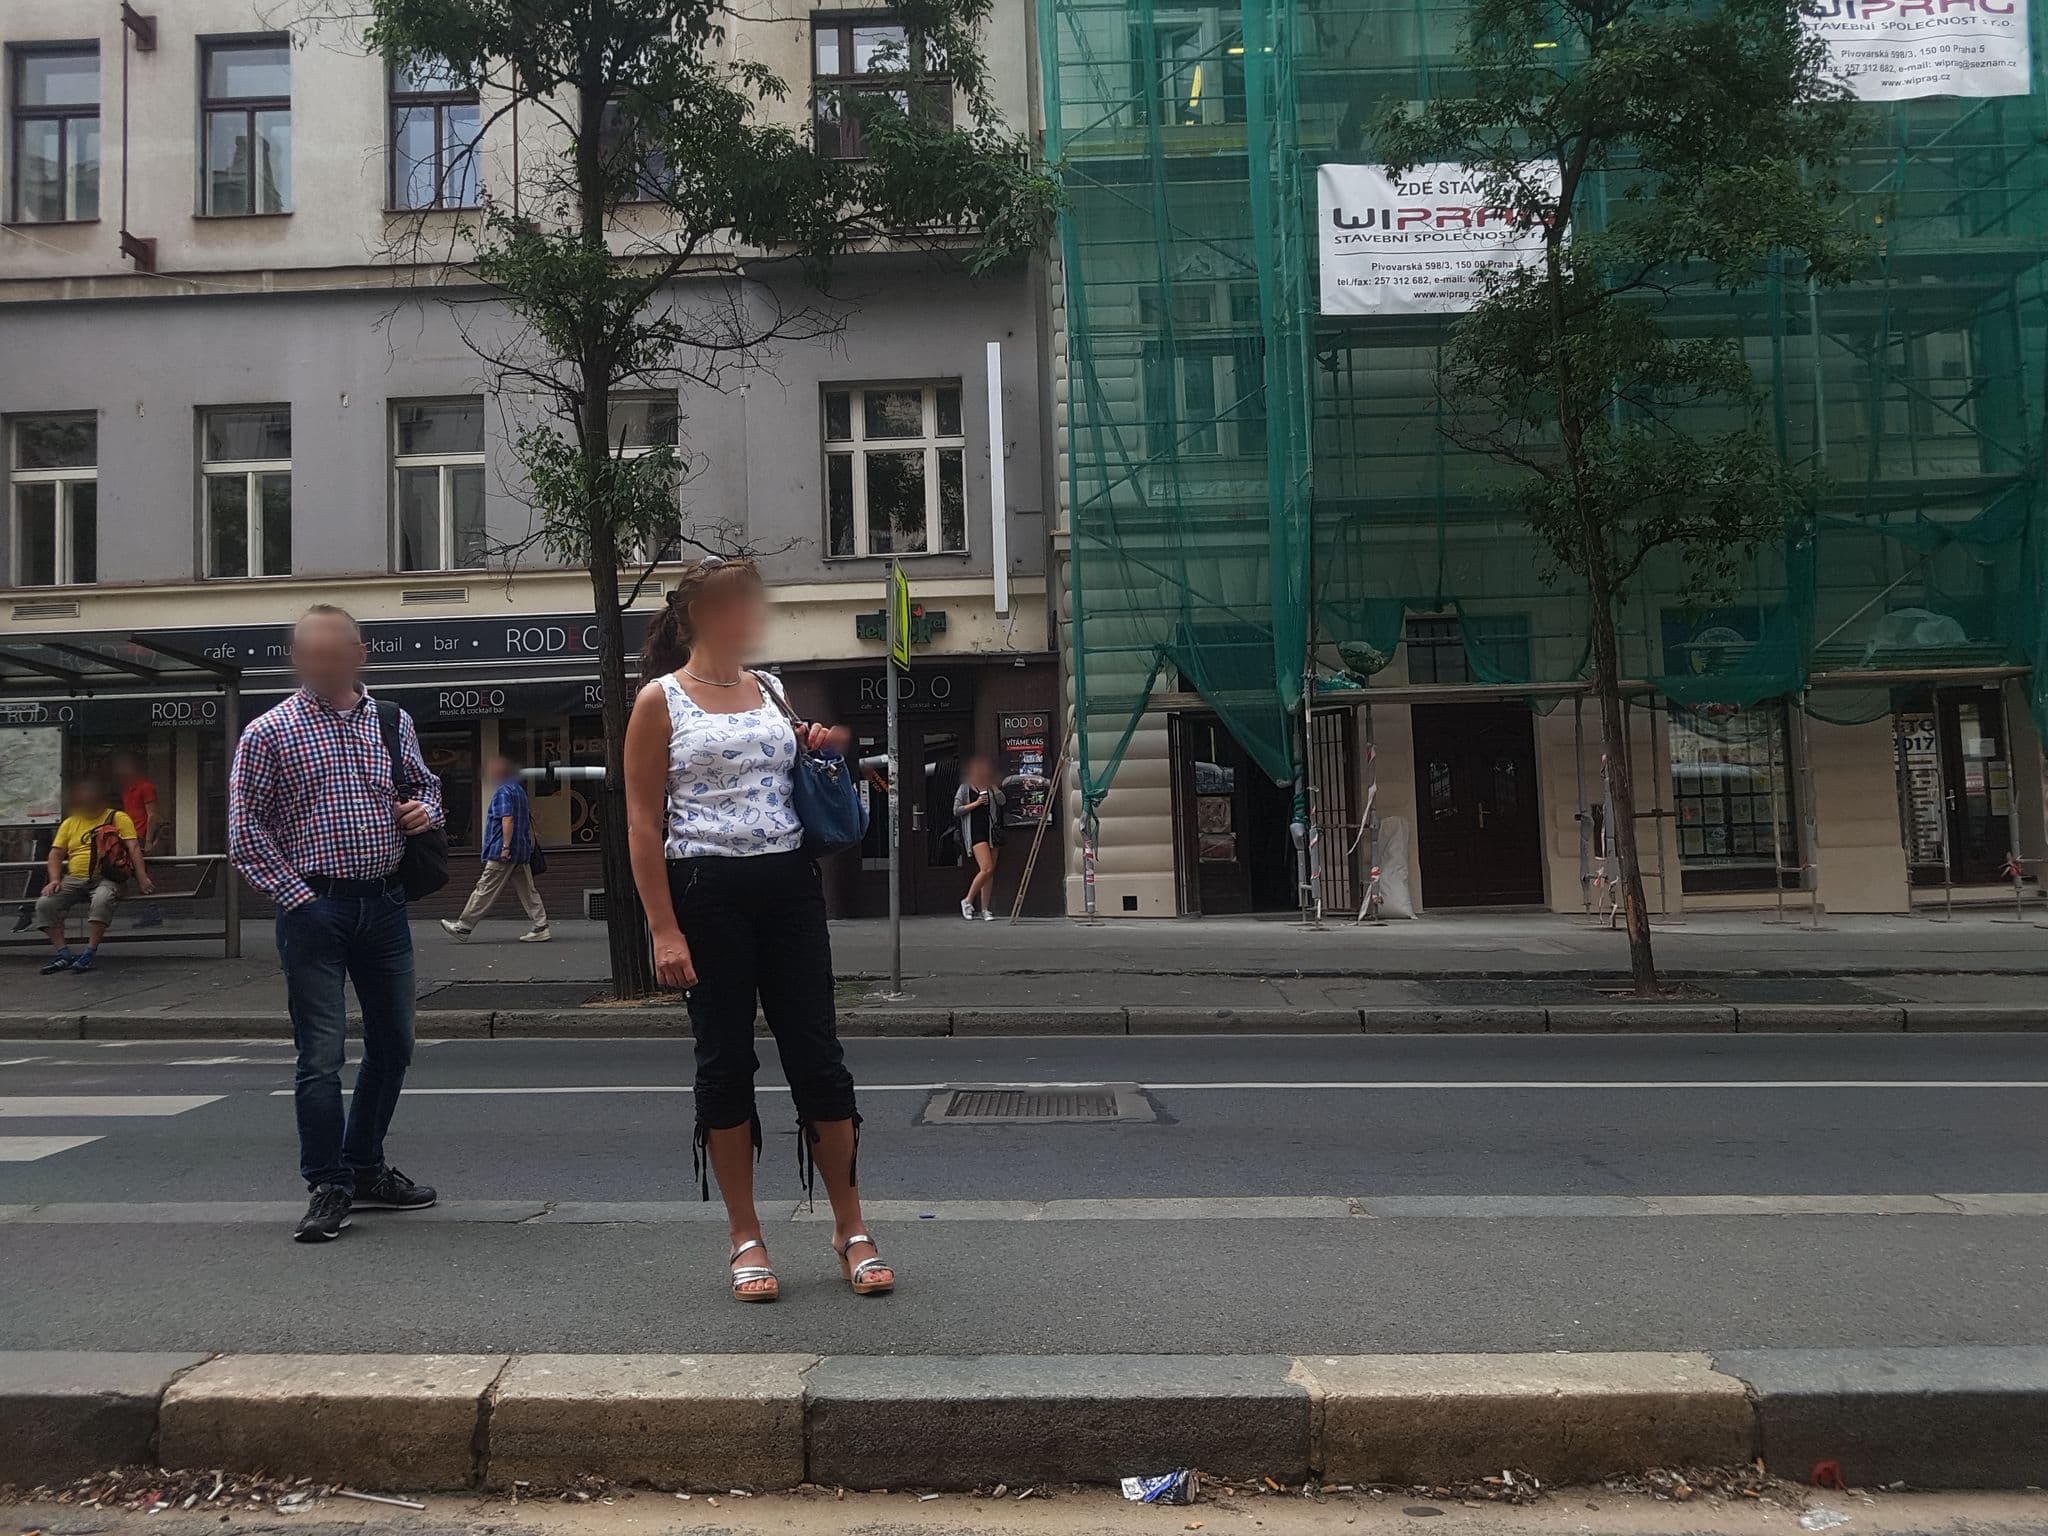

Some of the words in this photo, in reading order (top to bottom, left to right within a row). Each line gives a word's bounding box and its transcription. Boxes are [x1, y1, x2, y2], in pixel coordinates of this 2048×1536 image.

[1881, 15, 1977, 31] SPOLEČNOST
[1841, 49, 1889, 59] Pivovarská
[1920, 46, 1937, 55] 150
[1939, 45, 1951, 53] 00
[1953, 44, 1977, 54] Praha
[1979, 44, 1986, 53] 5
[1844, 63, 1859, 72] 257
[1862, 63, 1878, 72] 312
[1898, 62, 1931, 72] e-mail:
[1934, 59, 2016, 70] wiprag@seznam.cz
[1881, 73, 1950, 87] www.wiprag.cz
[1397, 181, 1433, 196] ZDE
[1439, 181, 1487, 195] STAV
[1334, 233, 1409, 244] STAVEBNÍ
[1414, 230, 1514, 242] SPOLEČNOST
[1371, 261, 1423, 271] Pivovarská
[1425, 261, 1452, 271] 598/3,
[1456, 260, 1472, 269] 150
[1487, 259, 1514, 269] Praha
[1374, 276, 1390, 286] 257
[1393, 276, 1410, 286] 312
[1412, 276, 1432, 286] 682,
[1434, 275, 1466, 285] e-mail:
[1413, 290, 1482, 300] www.wiprag.cz
[203, 642, 236, 659] cafe
[365, 636, 402, 654] cktail
[433, 635, 460, 651] bar
[439, 690, 505, 709] RODEO
[152, 701, 216, 720] RODEO
[466, 707, 492, 715] cocktail
[493, 706, 505, 714] bar
[1006, 737, 1030, 747] VÍTÁME
[1030, 736, 1044, 746] VÁS
